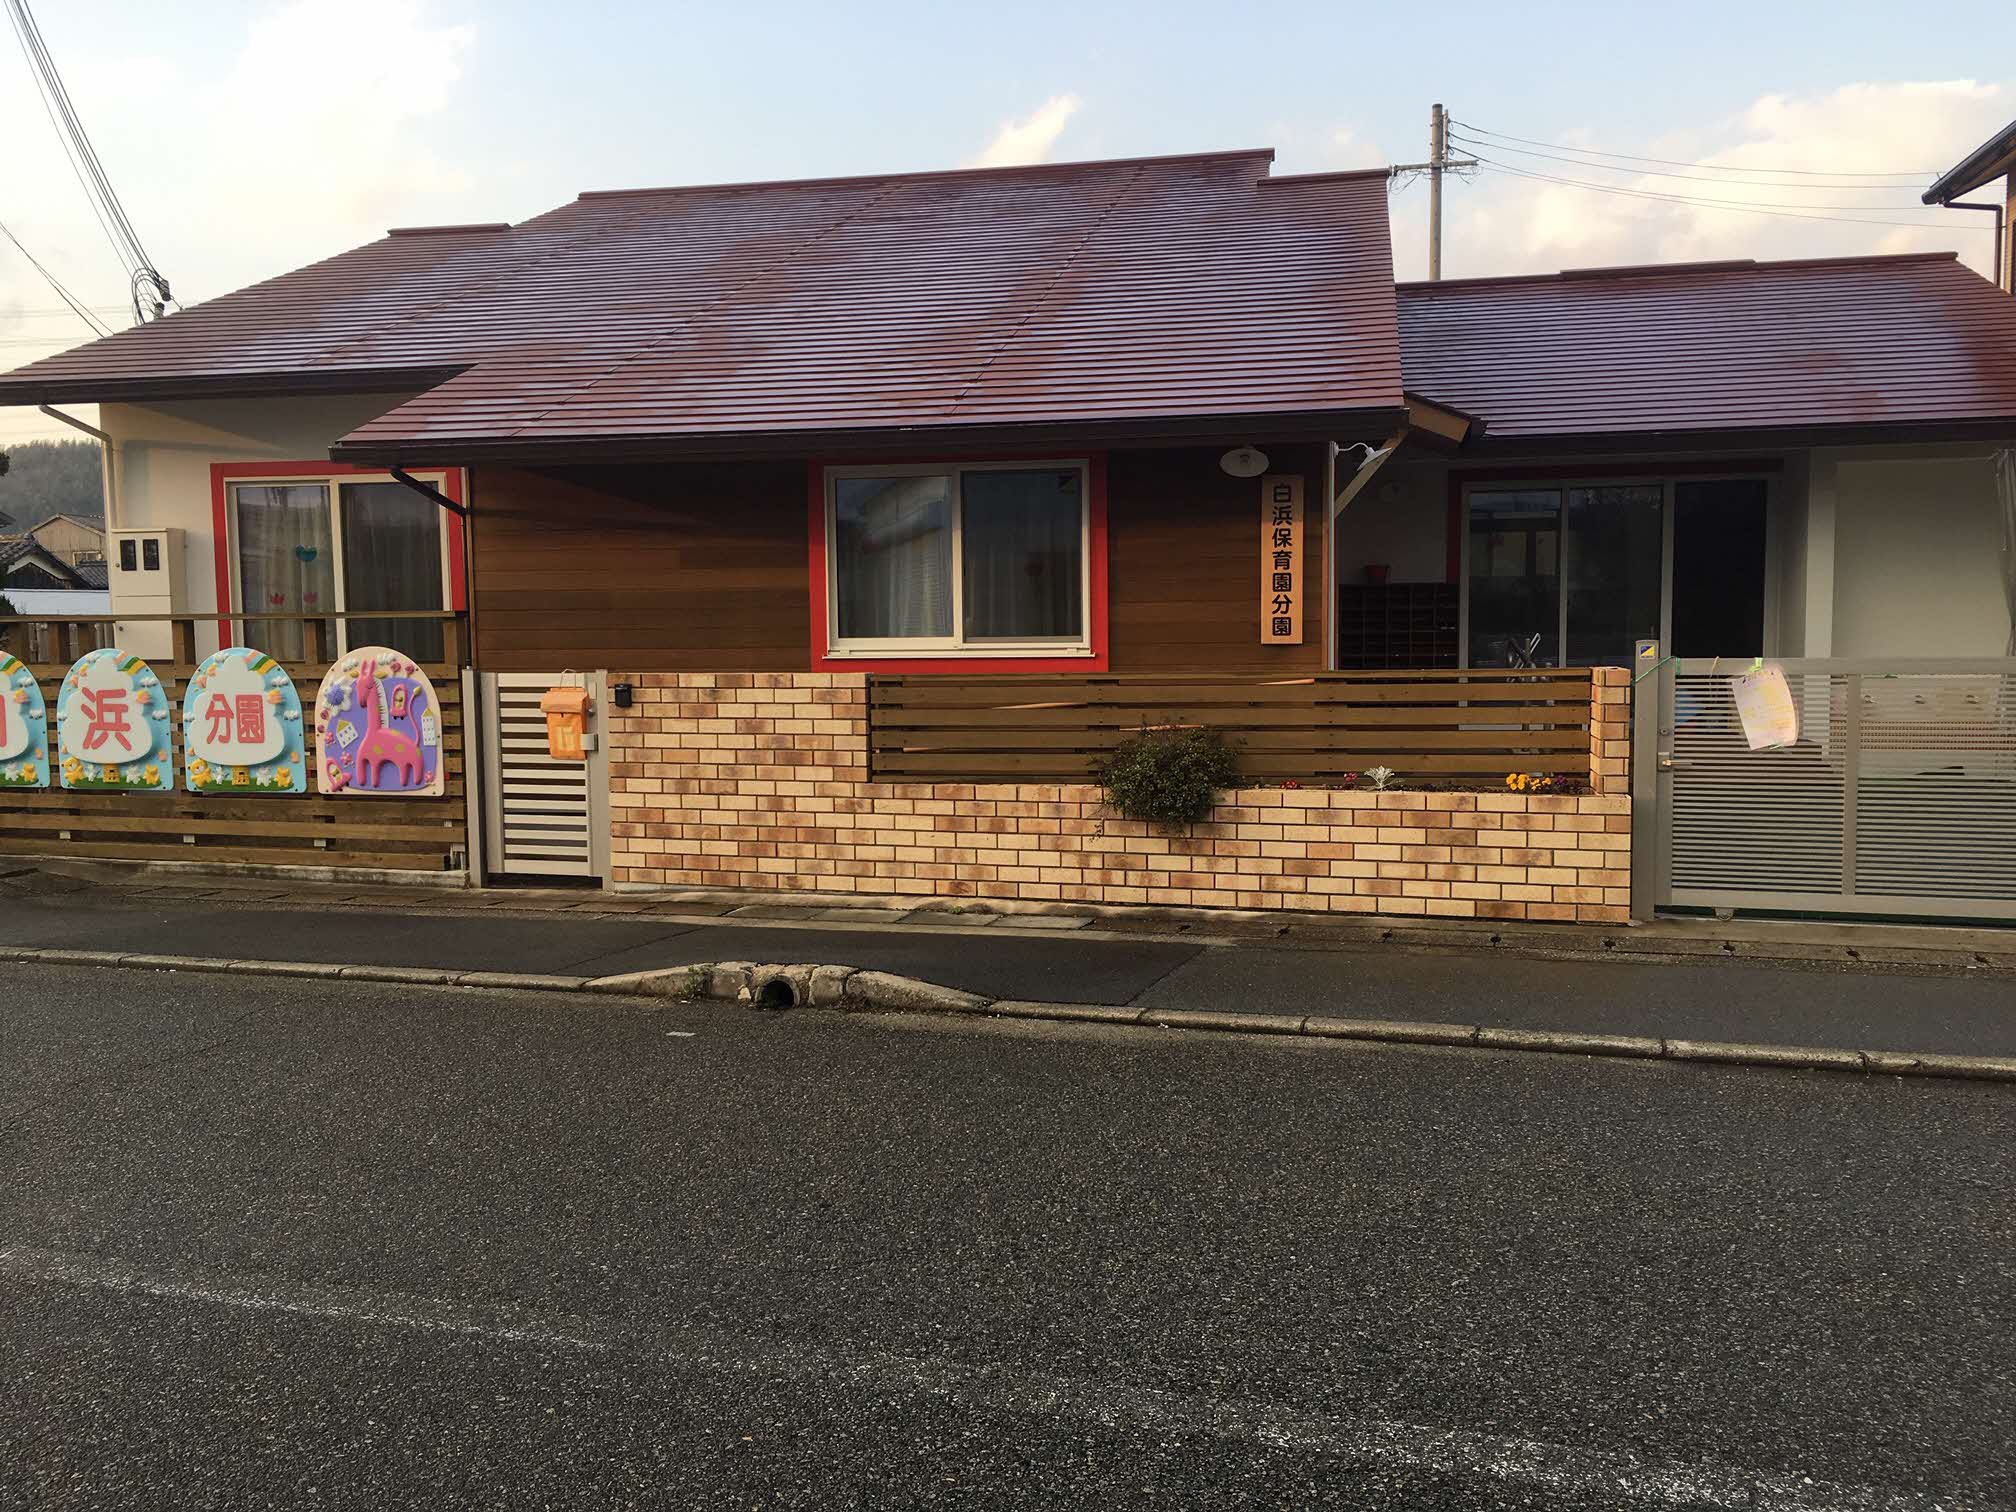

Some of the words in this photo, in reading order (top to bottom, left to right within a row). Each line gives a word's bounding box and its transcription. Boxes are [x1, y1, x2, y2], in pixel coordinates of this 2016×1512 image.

[1272, 483, 1293, 636] 白浜保育園分園
[81, 687, 132, 751] 浜
[205, 694, 265, 744] 分園
